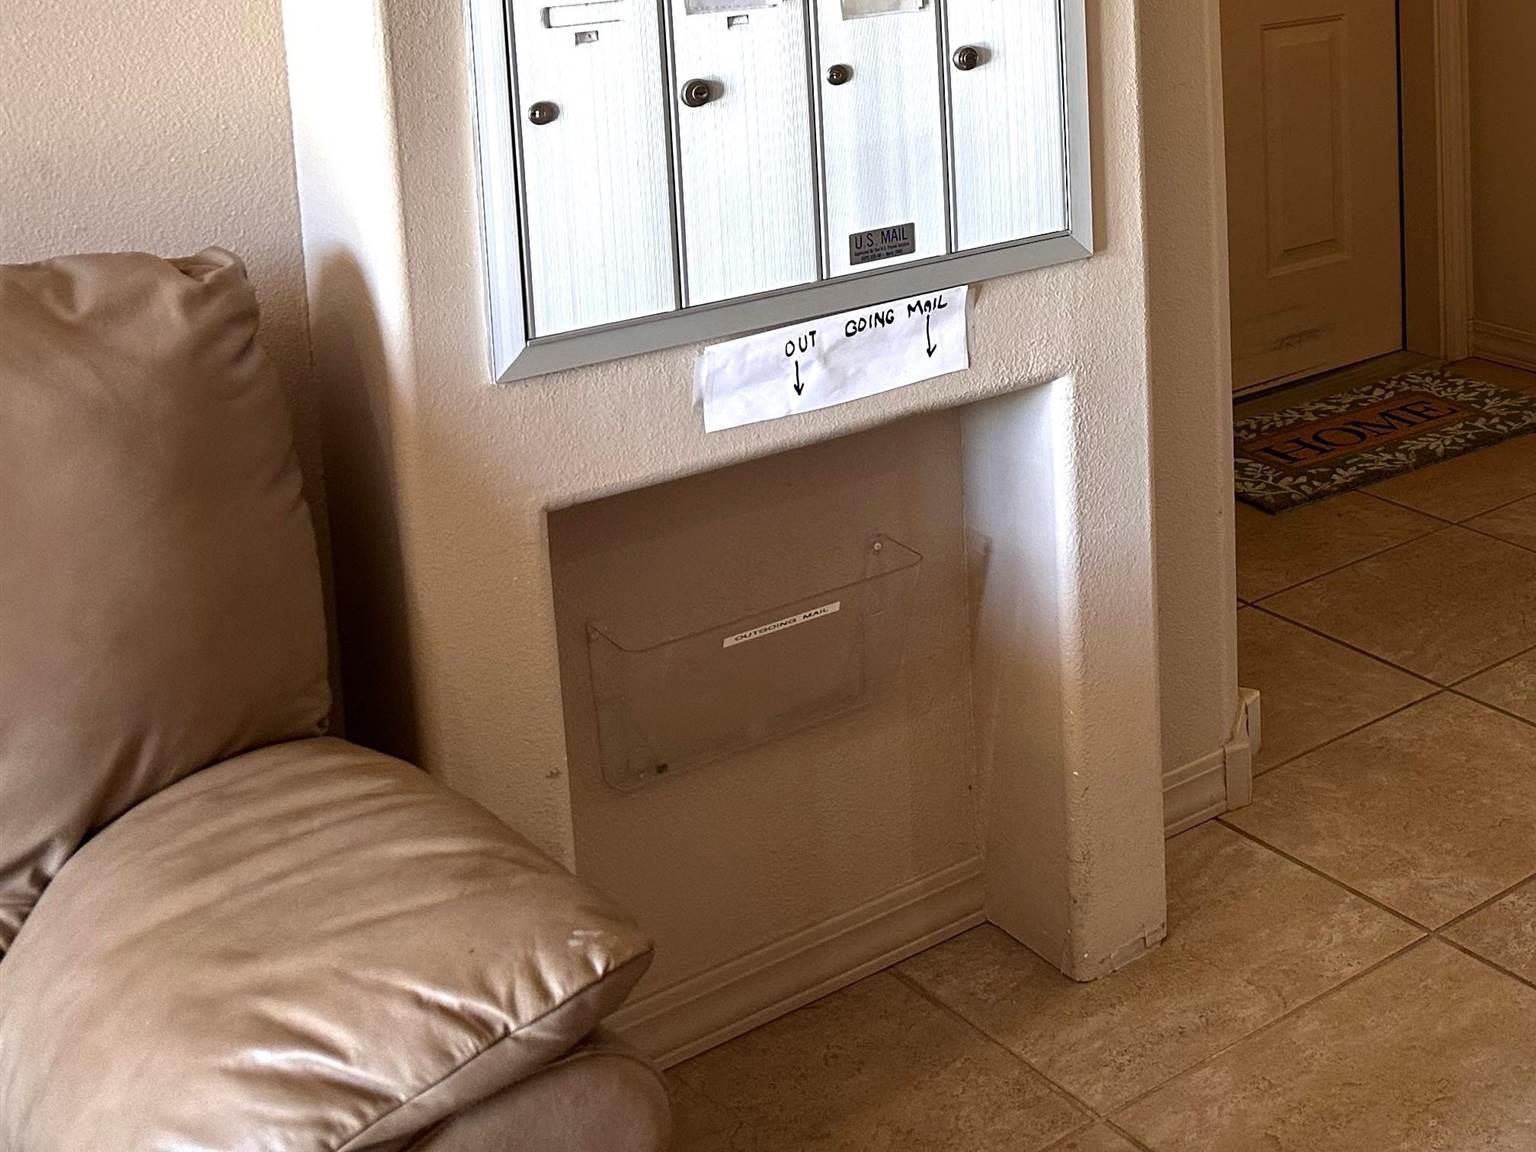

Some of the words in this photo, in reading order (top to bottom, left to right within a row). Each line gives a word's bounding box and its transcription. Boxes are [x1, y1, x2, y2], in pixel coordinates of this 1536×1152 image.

[881, 227, 908, 244] MAIL
[784, 330, 817, 357] OUT
[845, 309, 895, 337] GOING
[907, 295, 948, 317] MAIL
[1256, 400, 1461, 464] HOME
[734, 617, 797, 642] OUTGOING
[802, 608, 829, 621] MAIL
